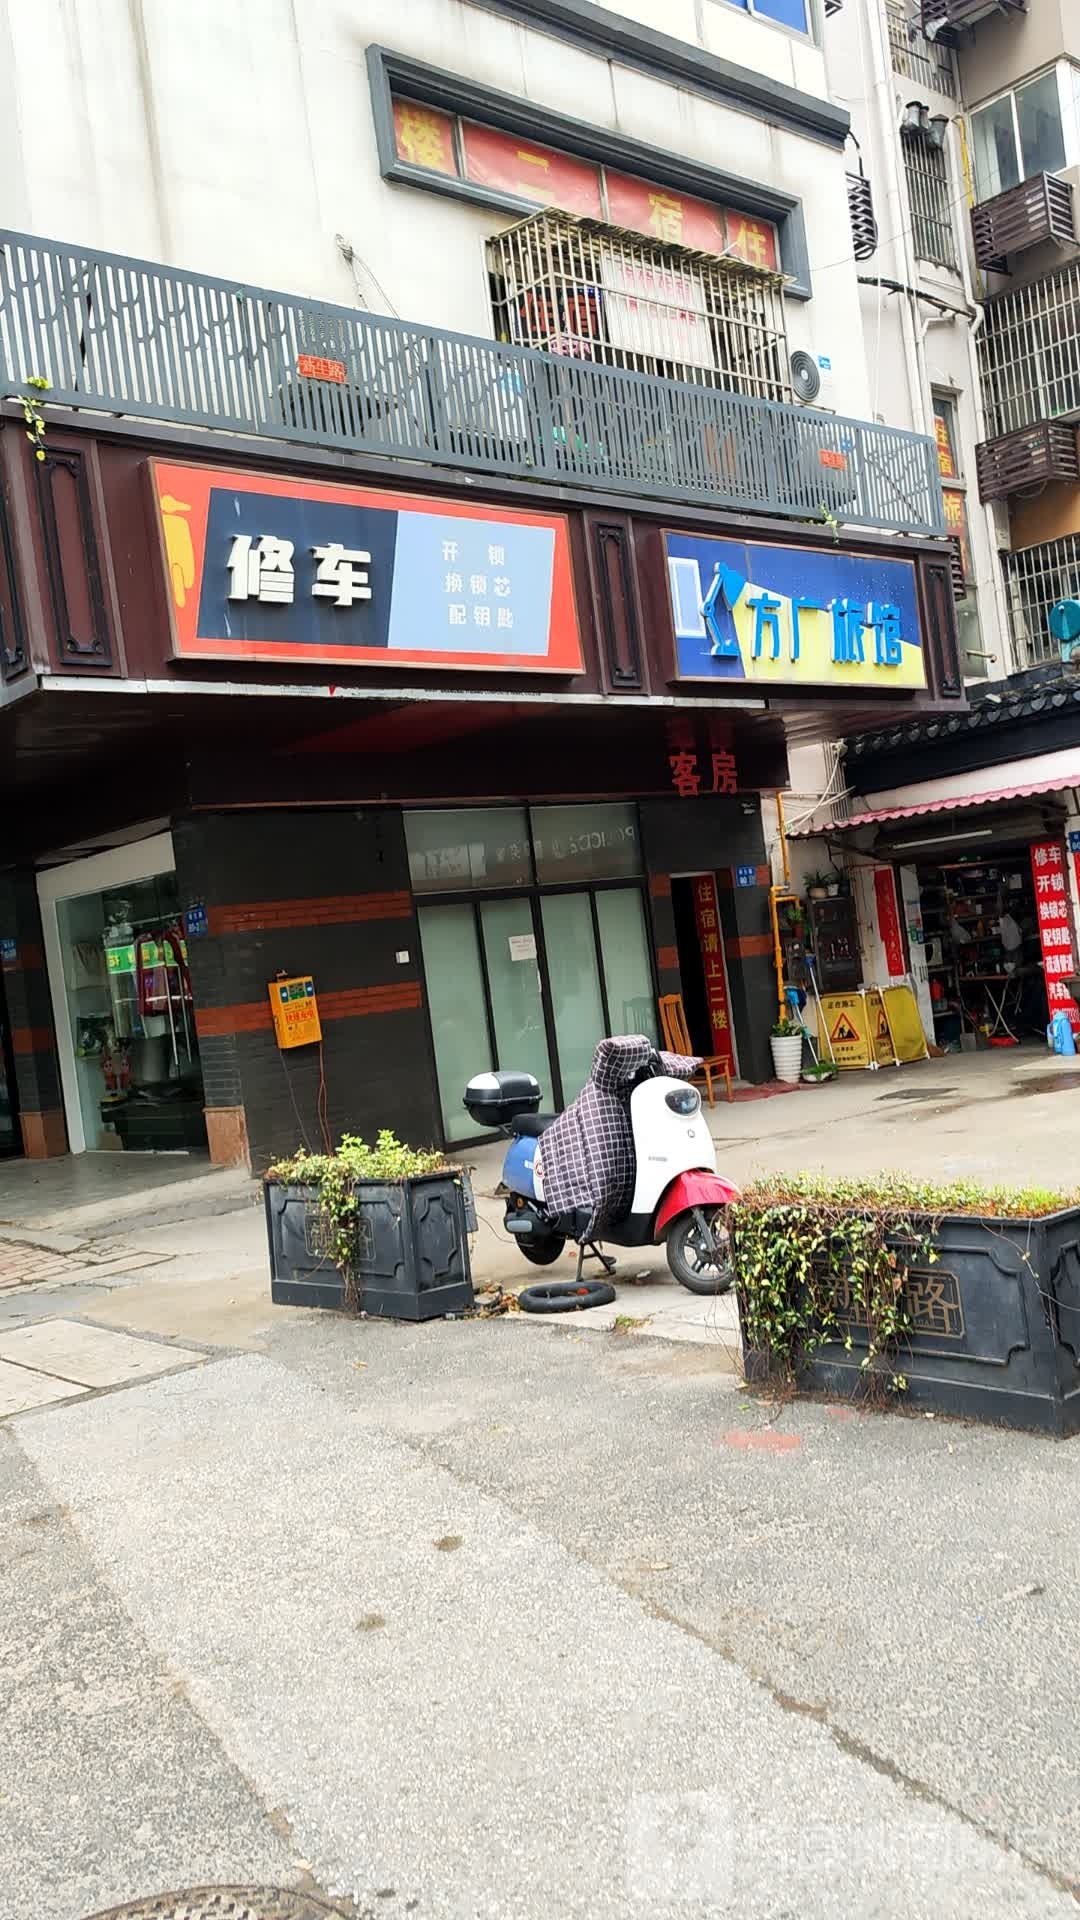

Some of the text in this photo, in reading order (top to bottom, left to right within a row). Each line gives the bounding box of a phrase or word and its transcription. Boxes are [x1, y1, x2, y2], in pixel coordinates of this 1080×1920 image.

[227, 534, 372, 606] 修车
[443, 571, 512, 597] 换锁芯
[447, 603, 513, 628] 配钥匙
[669, 751, 738, 797] 客房
[1034, 842, 1061, 867] 修车
[1036, 871, 1065, 894] 开锁
[1039, 899, 1068, 920] 换锁芯
[1042, 925, 1071, 947] 配钥匙
